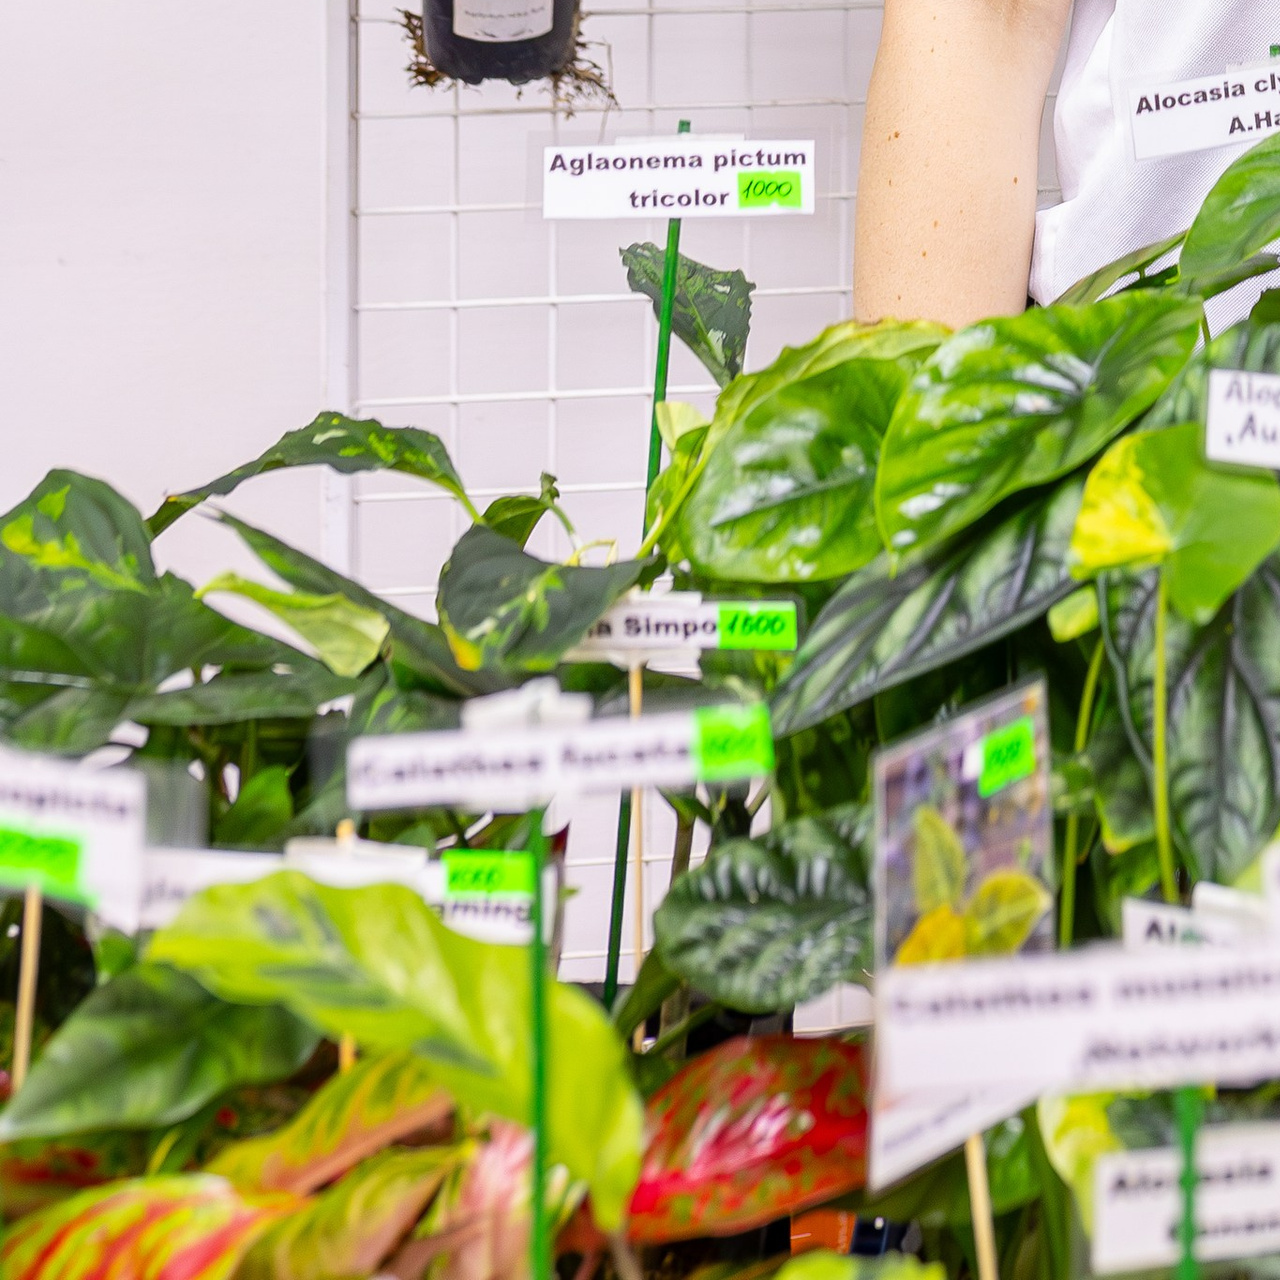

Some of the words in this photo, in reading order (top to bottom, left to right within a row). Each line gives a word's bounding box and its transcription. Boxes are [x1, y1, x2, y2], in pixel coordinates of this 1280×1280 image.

[1135, 80, 1246, 116] Alocasia
[549, 151, 703, 177] Aglaonema
[713, 148, 807, 173] pictum
[629, 189, 730, 209] tricolor
[742, 178, 793, 201] 1000
